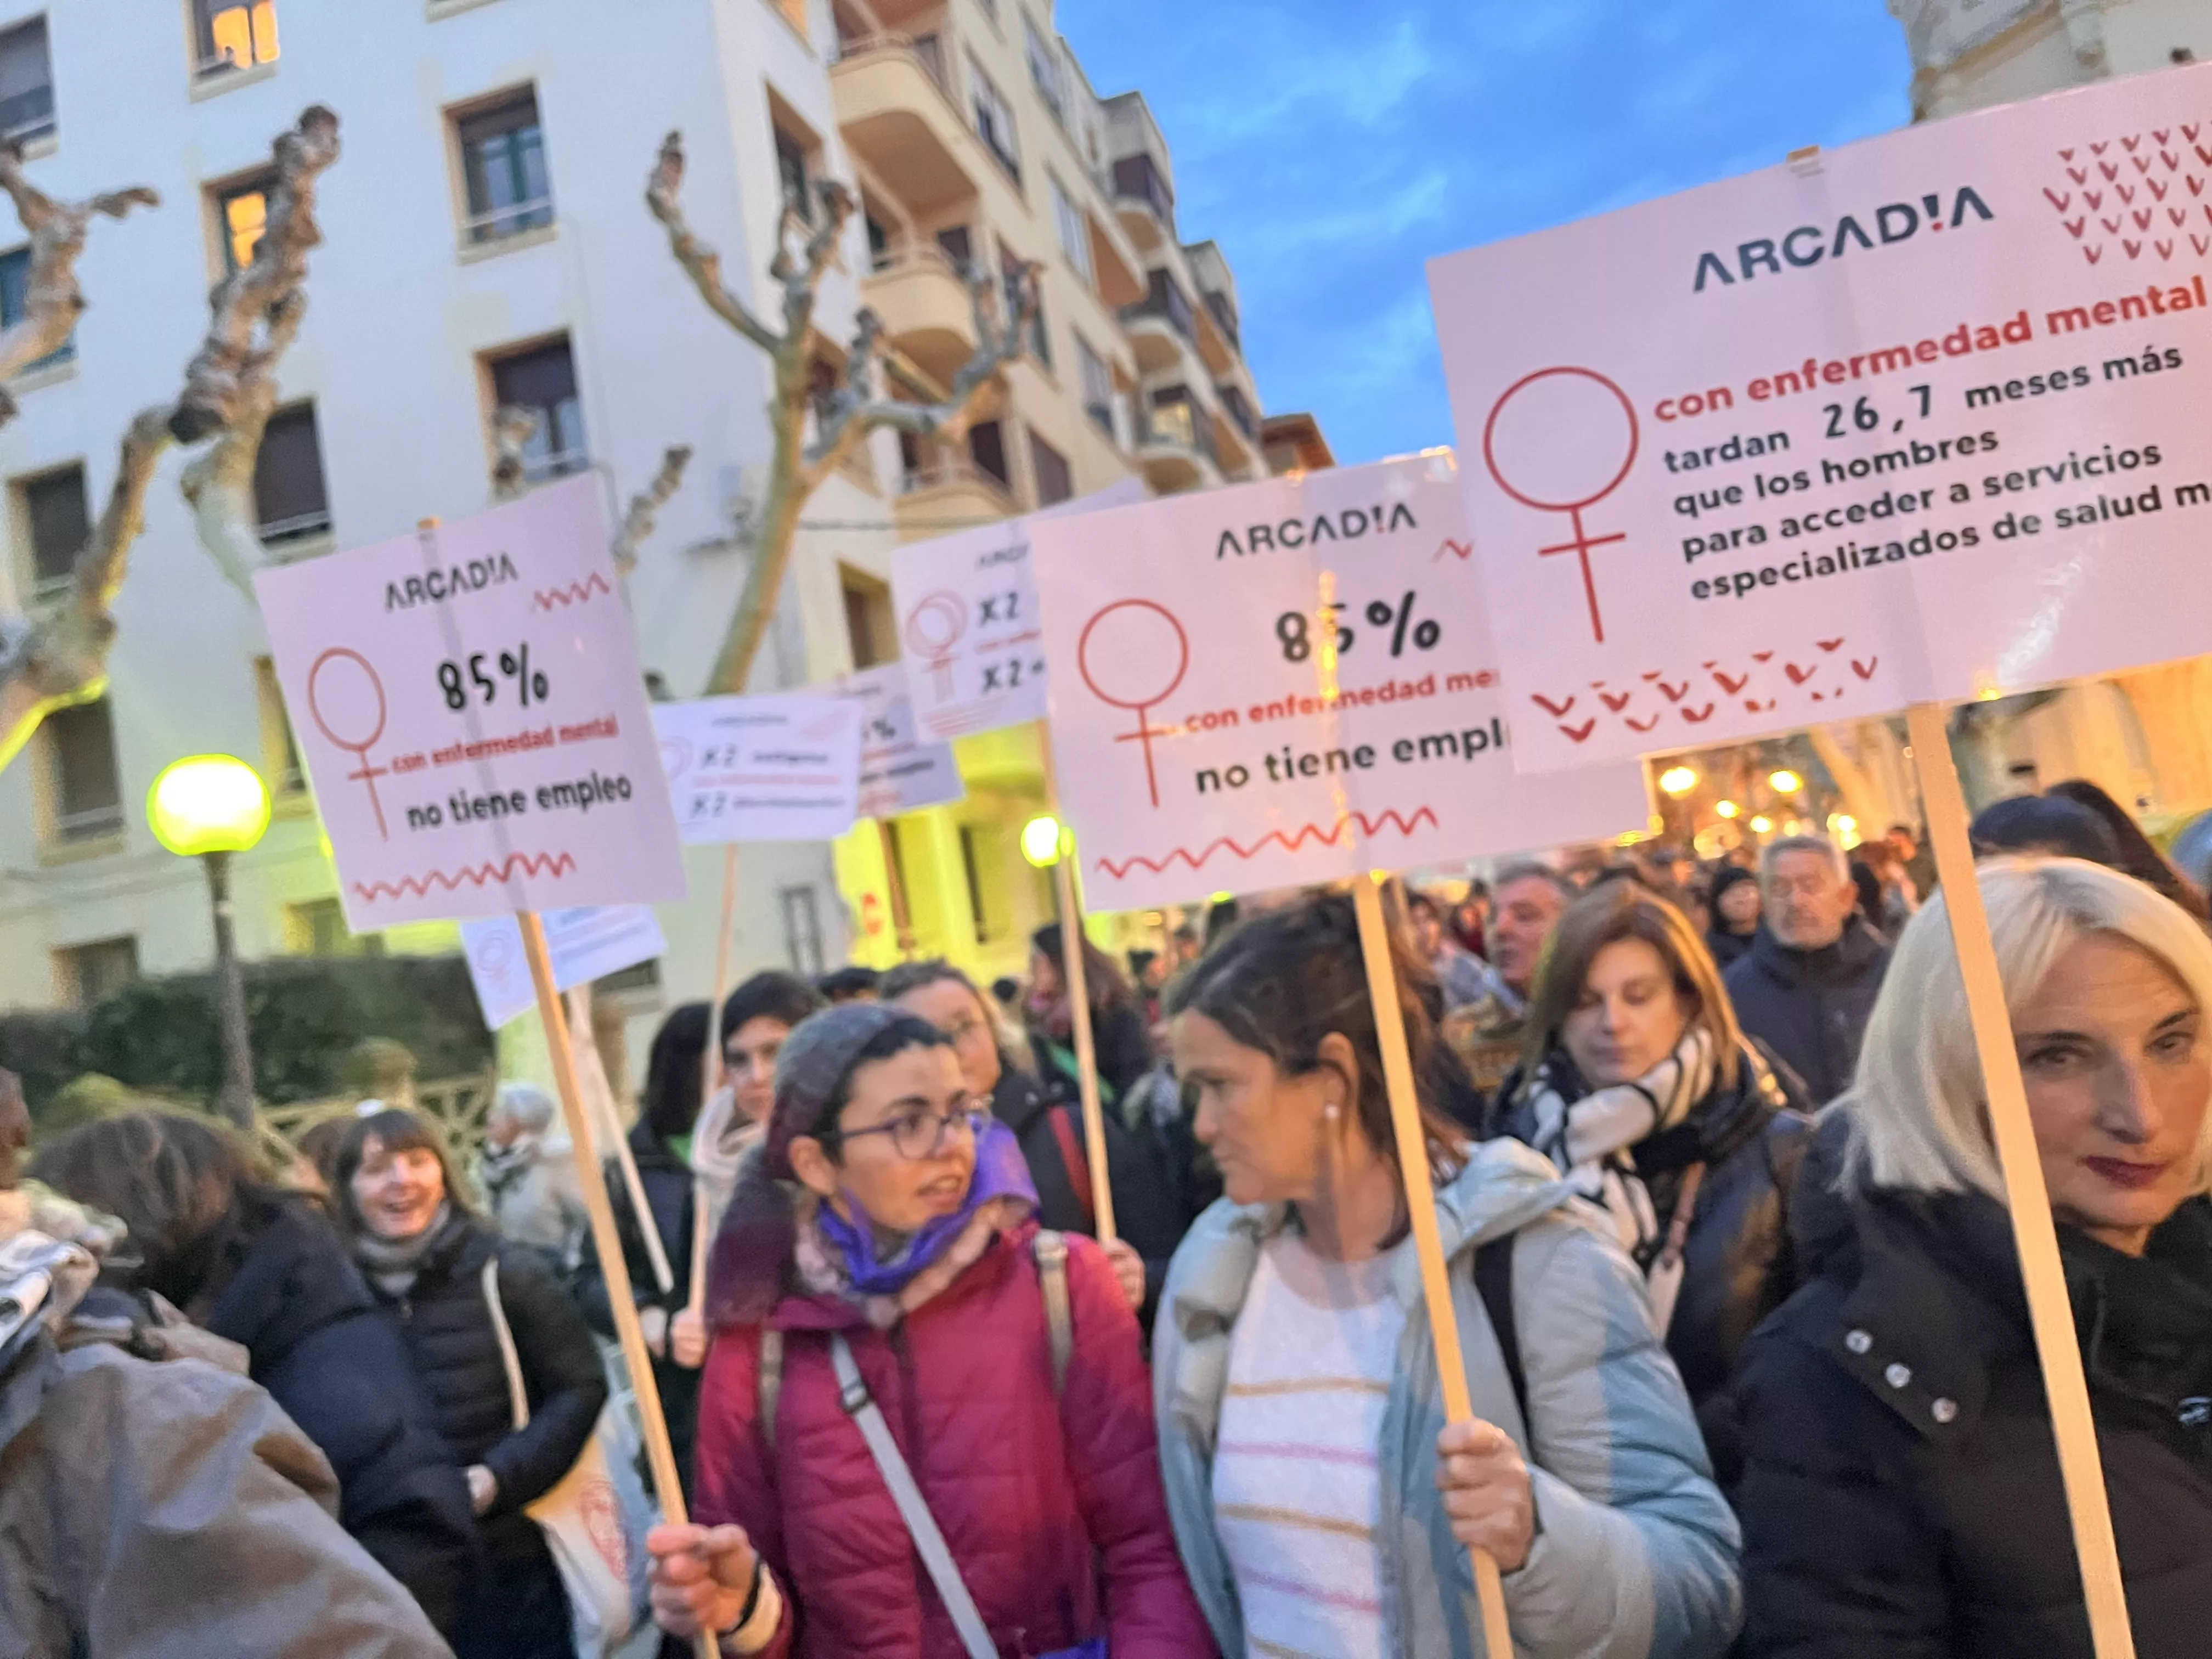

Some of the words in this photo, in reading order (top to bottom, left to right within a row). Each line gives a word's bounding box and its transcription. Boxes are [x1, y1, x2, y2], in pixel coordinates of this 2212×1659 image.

[1654, 386, 1734, 422] con
[1748, 310, 2033, 402] enfermedad
[2046, 275, 2207, 335] mental
[1664, 431, 1790, 473] tardan
[1823, 385, 1931, 438] 26,7
[1965, 366, 2091, 409] meses
[2103, 345, 2183, 380] más
[1674, 486, 1743, 518] que
[1754, 470, 1811, 499] los
[1821, 429, 1999, 484] hombres
[1682, 525, 1768, 563] para
[1781, 489, 1934, 538] acceder
[1949, 483, 1971, 504] a
[1983, 444, 2162, 497] servicios
[1691, 525, 1980, 599] especializados
[1992, 512, 2041, 540] de
[2055, 484, 2162, 528] salud
[2174, 483, 2212, 506] m
[438, 643, 548, 711] 85%
[1184, 708, 1239, 732] con
[1248, 675, 1436, 723] enfermedad
[1446, 669, 1500, 692] me
[392, 753, 428, 773] con
[432, 726, 555, 766] enfermedad
[559, 715, 619, 743] mental
[1196, 765, 1249, 793] no
[1264, 744, 1376, 782] tiene
[1392, 716, 1506, 763] empl
[407, 804, 442, 830] no
[449, 790, 527, 822] tiene
[536, 771, 632, 811] empleo
